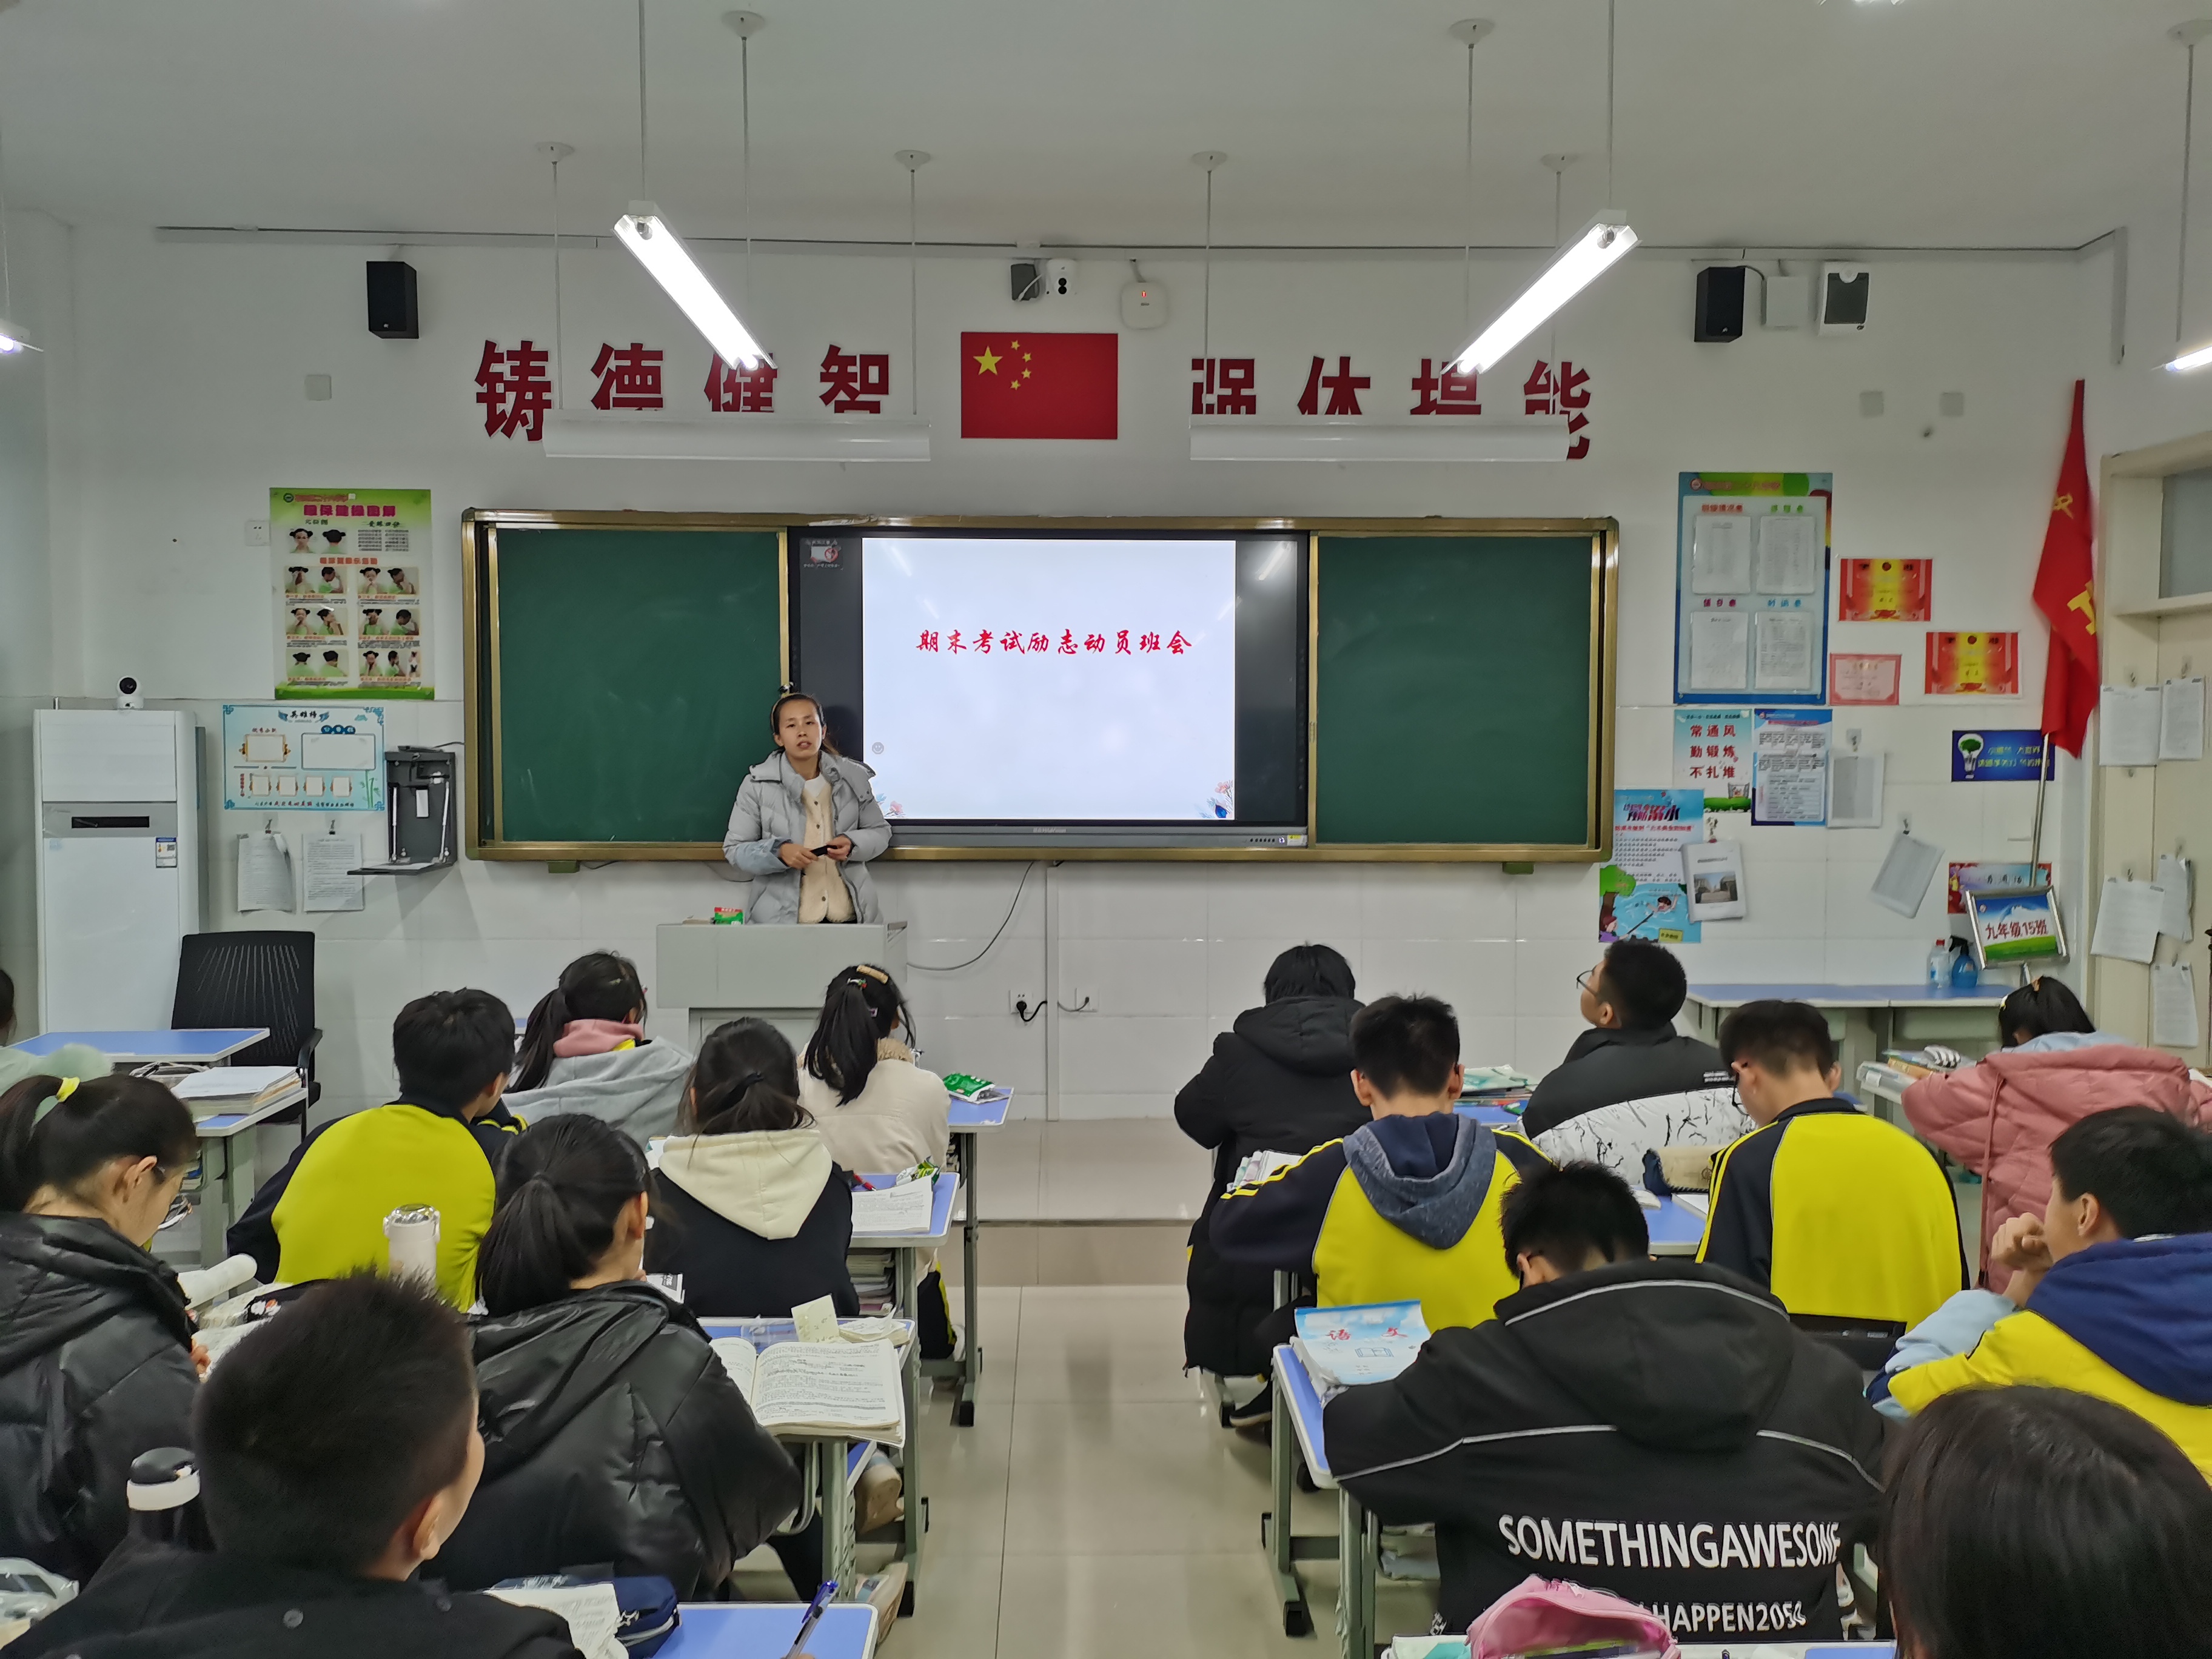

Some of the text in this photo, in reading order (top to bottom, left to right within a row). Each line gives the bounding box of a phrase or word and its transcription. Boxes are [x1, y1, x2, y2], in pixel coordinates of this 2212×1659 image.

[916, 628, 1192, 655] 期末考试励志动员班会
[1690, 724, 1736, 737] 常通风
[1690, 745, 1735, 758] 勤锻炼
[1689, 765, 1735, 779] 不扎堆
